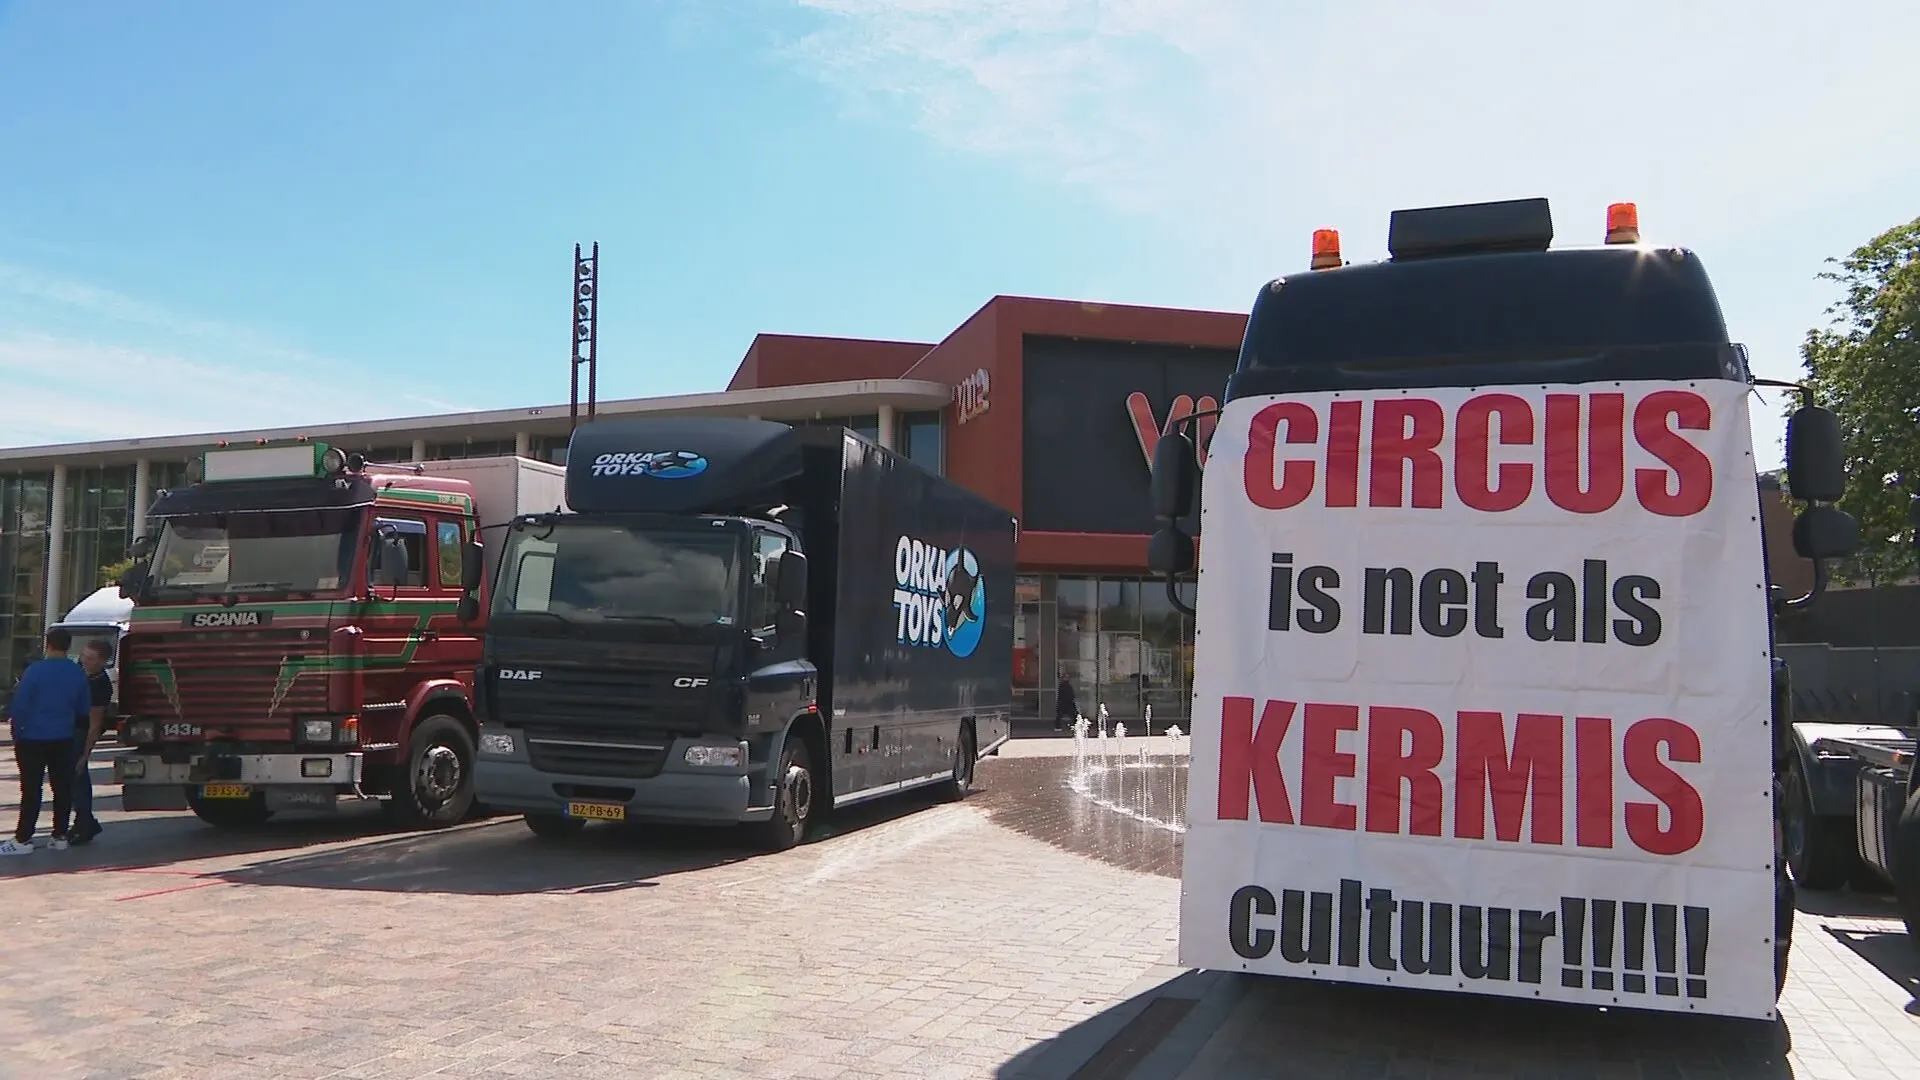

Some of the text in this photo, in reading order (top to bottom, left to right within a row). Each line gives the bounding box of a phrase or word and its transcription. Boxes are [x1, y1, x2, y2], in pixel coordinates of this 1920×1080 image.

[591, 463, 645, 476] TOYS
[595, 452, 654, 464] ORKA
[1243, 390, 1713, 517] CIRCUS
[895, 535, 947, 595] ORKA
[893, 588, 942, 646] TOYS
[1268, 552, 1662, 646] is net als
[193, 612, 259, 627] SCANIA
[499, 669, 542, 681] DAF
[673, 677, 709, 689] CF
[1217, 696, 1704, 856] KERMIS
[573, 804, 621, 818] BZ-PB-69
[1229, 878, 1710, 999] cultuur!!!!!
